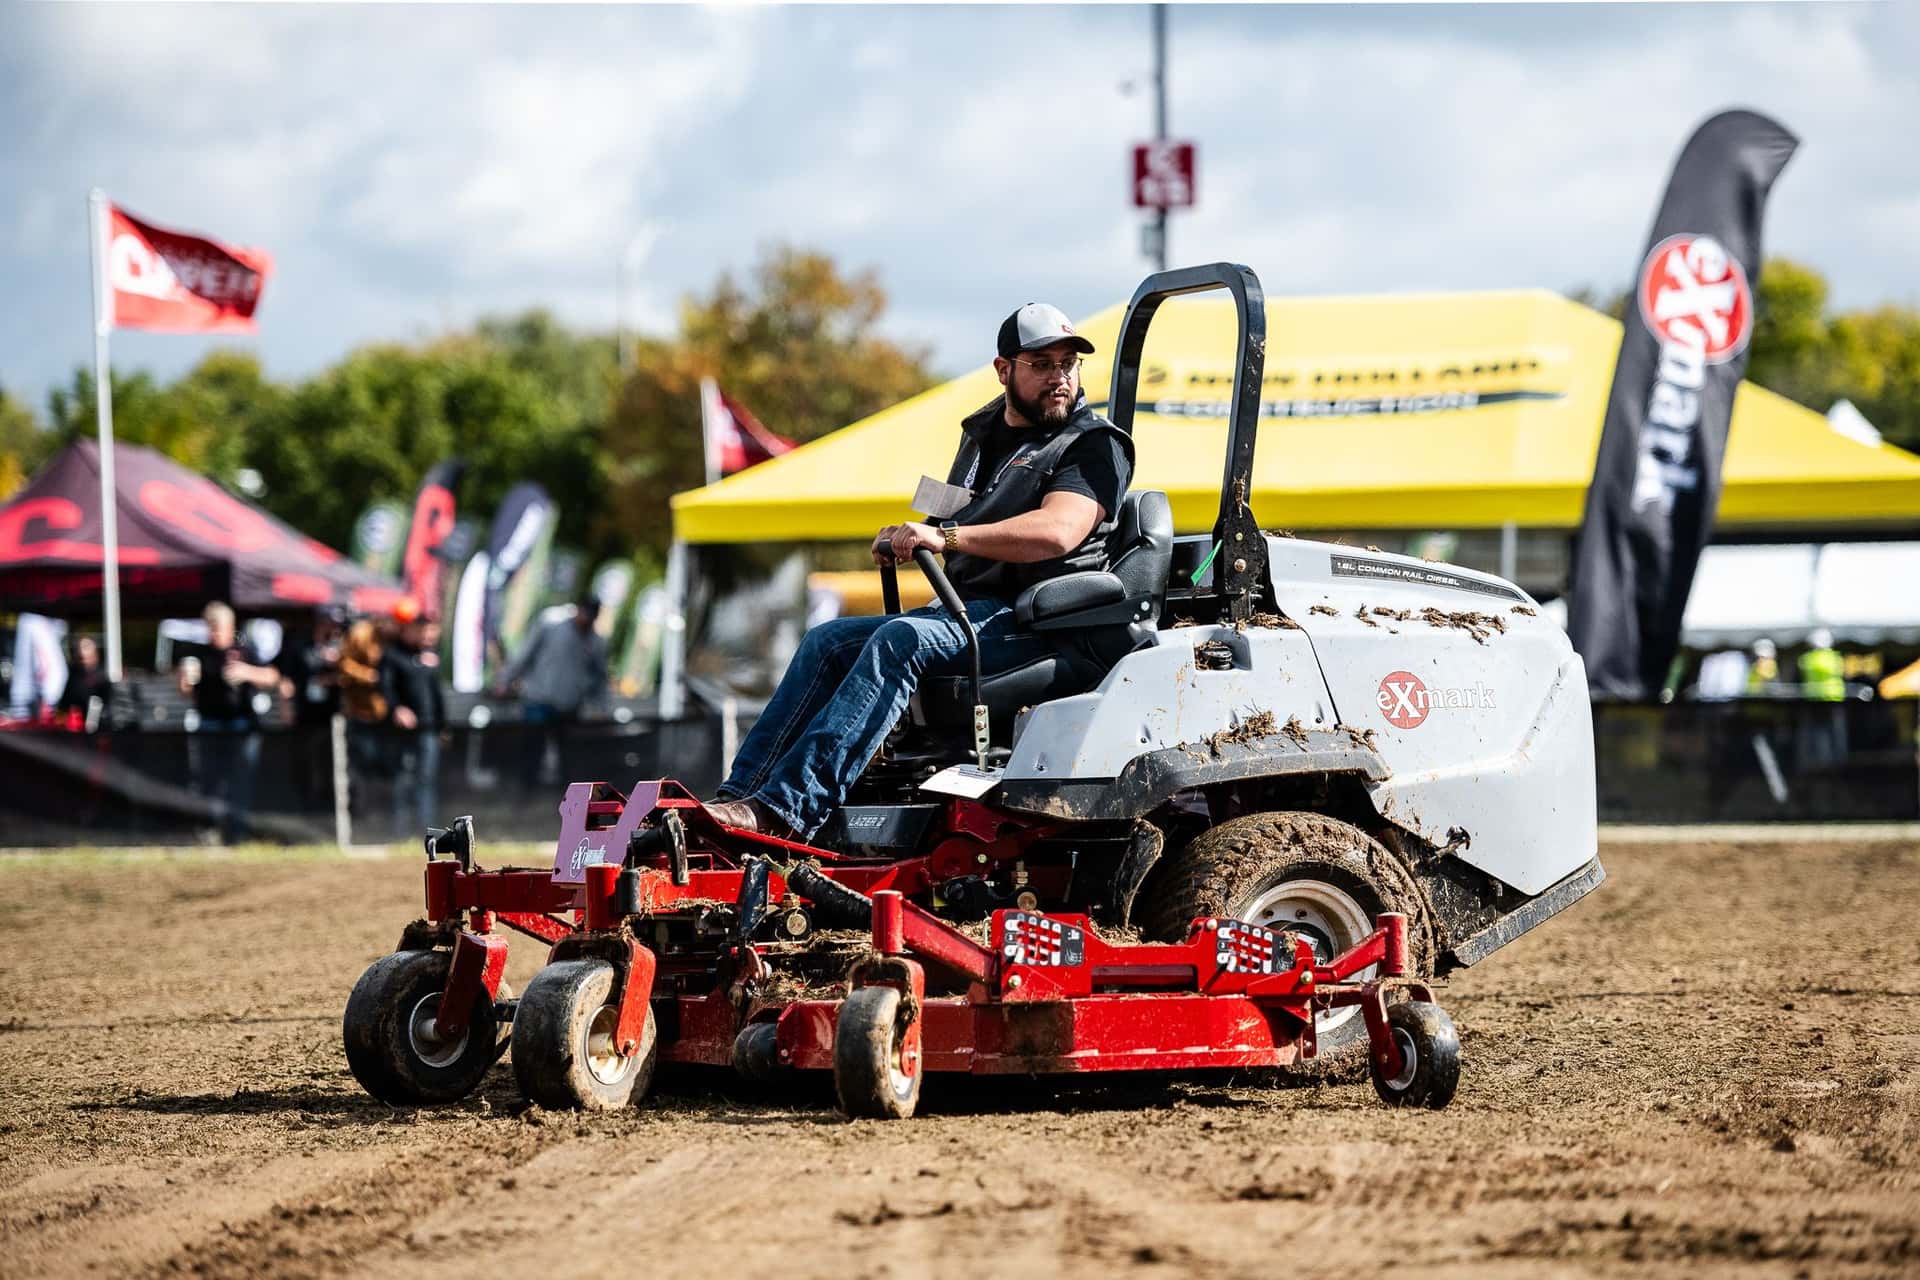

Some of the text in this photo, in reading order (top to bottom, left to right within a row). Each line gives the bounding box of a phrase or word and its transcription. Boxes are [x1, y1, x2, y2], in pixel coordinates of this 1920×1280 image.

[1358, 564, 1401, 577] COMMON
[1402, 569, 1425, 580] RAIL
[1426, 573, 1460, 586] DIESEL
[1376, 680, 1497, 719] eXmark
